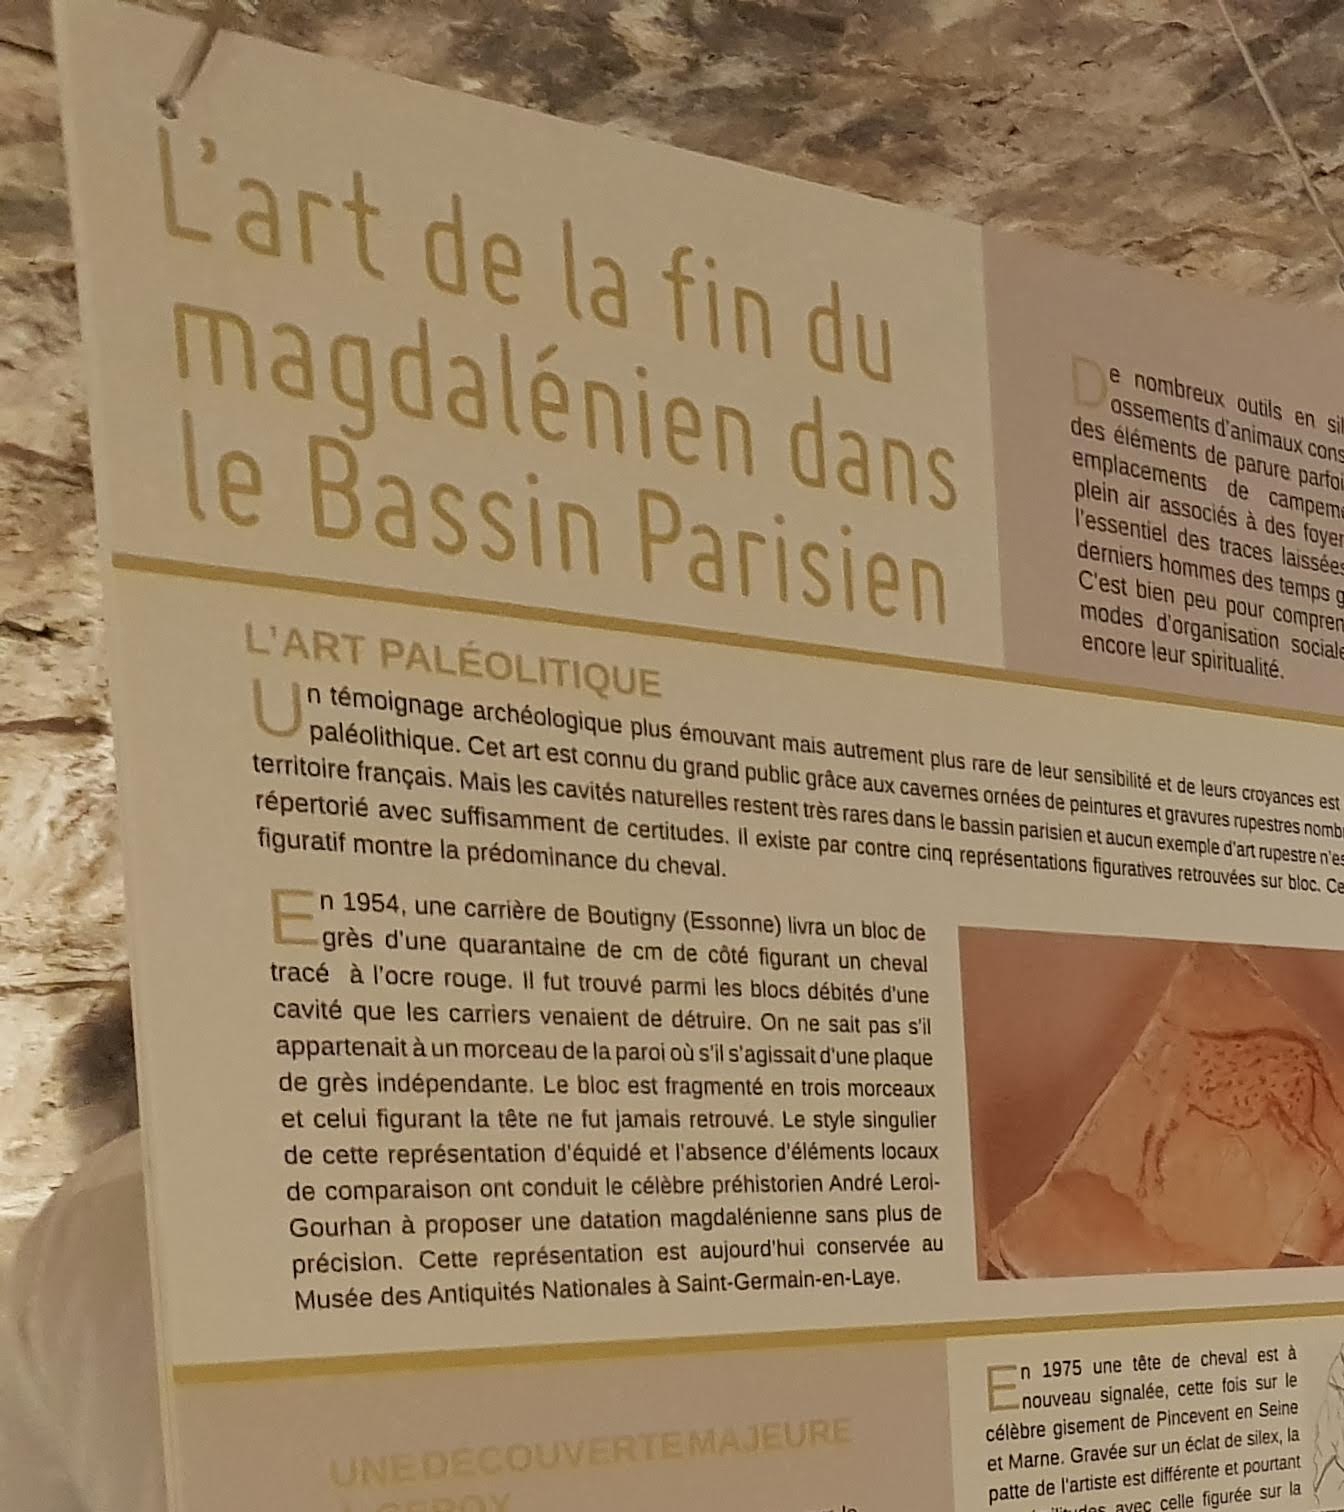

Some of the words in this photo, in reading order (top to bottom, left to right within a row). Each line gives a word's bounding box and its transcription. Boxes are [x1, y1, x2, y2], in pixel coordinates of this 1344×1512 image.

[158, 126, 386, 280] L'art
[423, 193, 523, 305] de
[564, 219, 628, 330] la
[662, 245, 772, 360] fin
[807, 280, 895, 384] du
[172, 301, 755, 478] magdalénien
[790, 395, 959, 512] dans
[1070, 416, 1106, 442] des
[1113, 424, 1198, 461] éléments
[1204, 444, 1228, 468] de
[1234, 454, 1291, 481] parure
[182, 409, 263, 527] le
[308, 432, 601, 576] Bassin
[639, 488, 948, 626] Parisien
[1076, 539, 1154, 572] derniers
[1158, 552, 1237, 586] hommes
[1241, 568, 1274, 593] des
[1278, 576, 1331, 605] temps
[244, 621, 367, 666] L'ART
[380, 638, 662, 699] PALÉOLITIQUE
[255, 789, 369, 818] répertorié
[378, 802, 433, 823] avec
[440, 804, 587, 835] suffisamment
[256, 825, 347, 854] figuratif
[353, 837, 433, 859] montre
[439, 838, 461, 861] la
[466, 841, 618, 871] prédominance
[624, 851, 650, 873] du
[656, 855, 726, 878] cheval.
[278, 1071, 308, 1093] de
[316, 1070, 369, 1098] grès
[377, 1071, 534, 1099] indépendante.
[543, 1075, 569, 1095] Le
[576, 1074, 620, 1095] bloc
[627, 1077, 659, 1096] est
[664, 1075, 764, 1100] fragmenté
[770, 1081, 795, 1097] en
[801, 1077, 841, 1097] trois
[847, 1081, 936, 1098] morceaux
[294, 1287, 373, 1311] Musée
[380, 1285, 423, 1307] des
[427, 1280, 536, 1307] Antiquités
[541, 1276, 652, 1300] Nationales
[657, 1274, 671, 1295] à
[676, 1268, 901, 1294] Saint-Germain-en-Laye.
[1159, 1492, 1195, 1512] celle
[1201, 1486, 1253, 1510] figurée
[1259, 1485, 1283, 1501] sur
[1288, 1480, 1302, 1496] la
